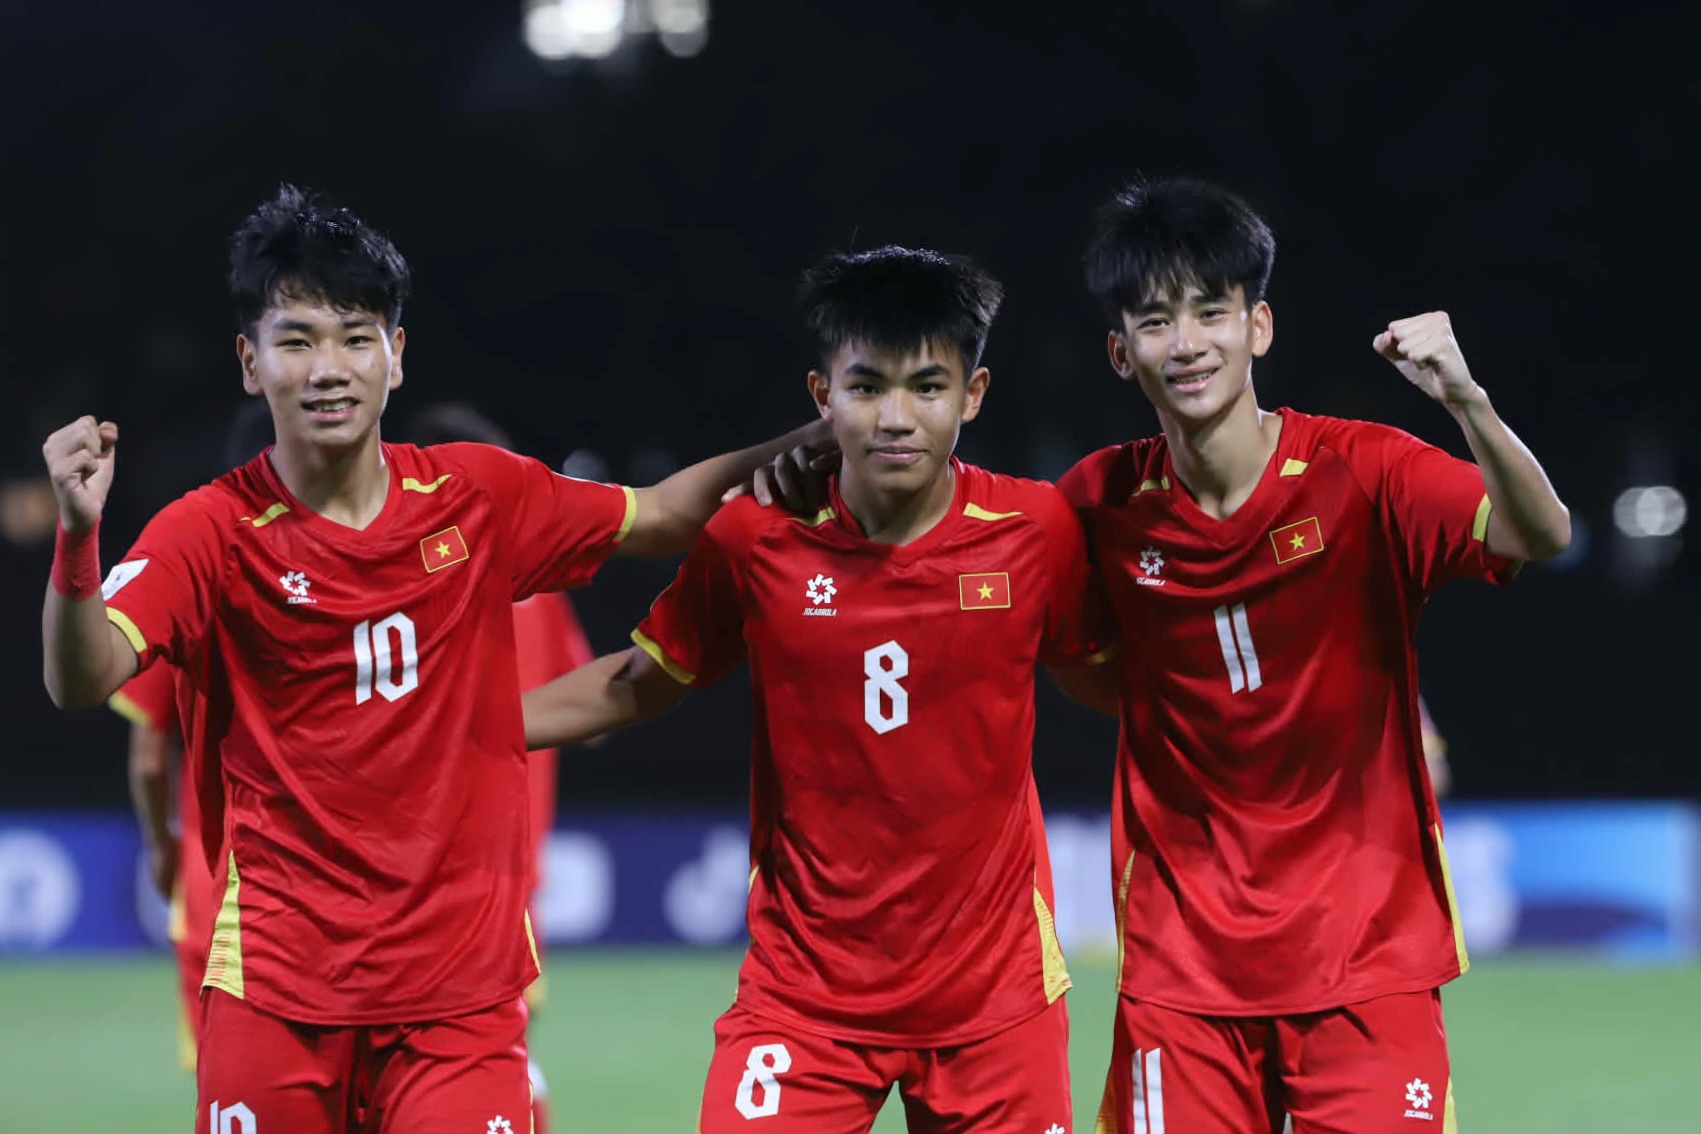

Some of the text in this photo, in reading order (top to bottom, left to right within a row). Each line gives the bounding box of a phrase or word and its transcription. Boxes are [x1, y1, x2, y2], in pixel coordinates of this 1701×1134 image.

[353, 611, 419, 706] 10
[863, 639, 909, 735] 8
[1213, 602, 1263, 695] 11
[734, 1043, 793, 1121] 8
[1131, 1047, 1166, 1134] 11
